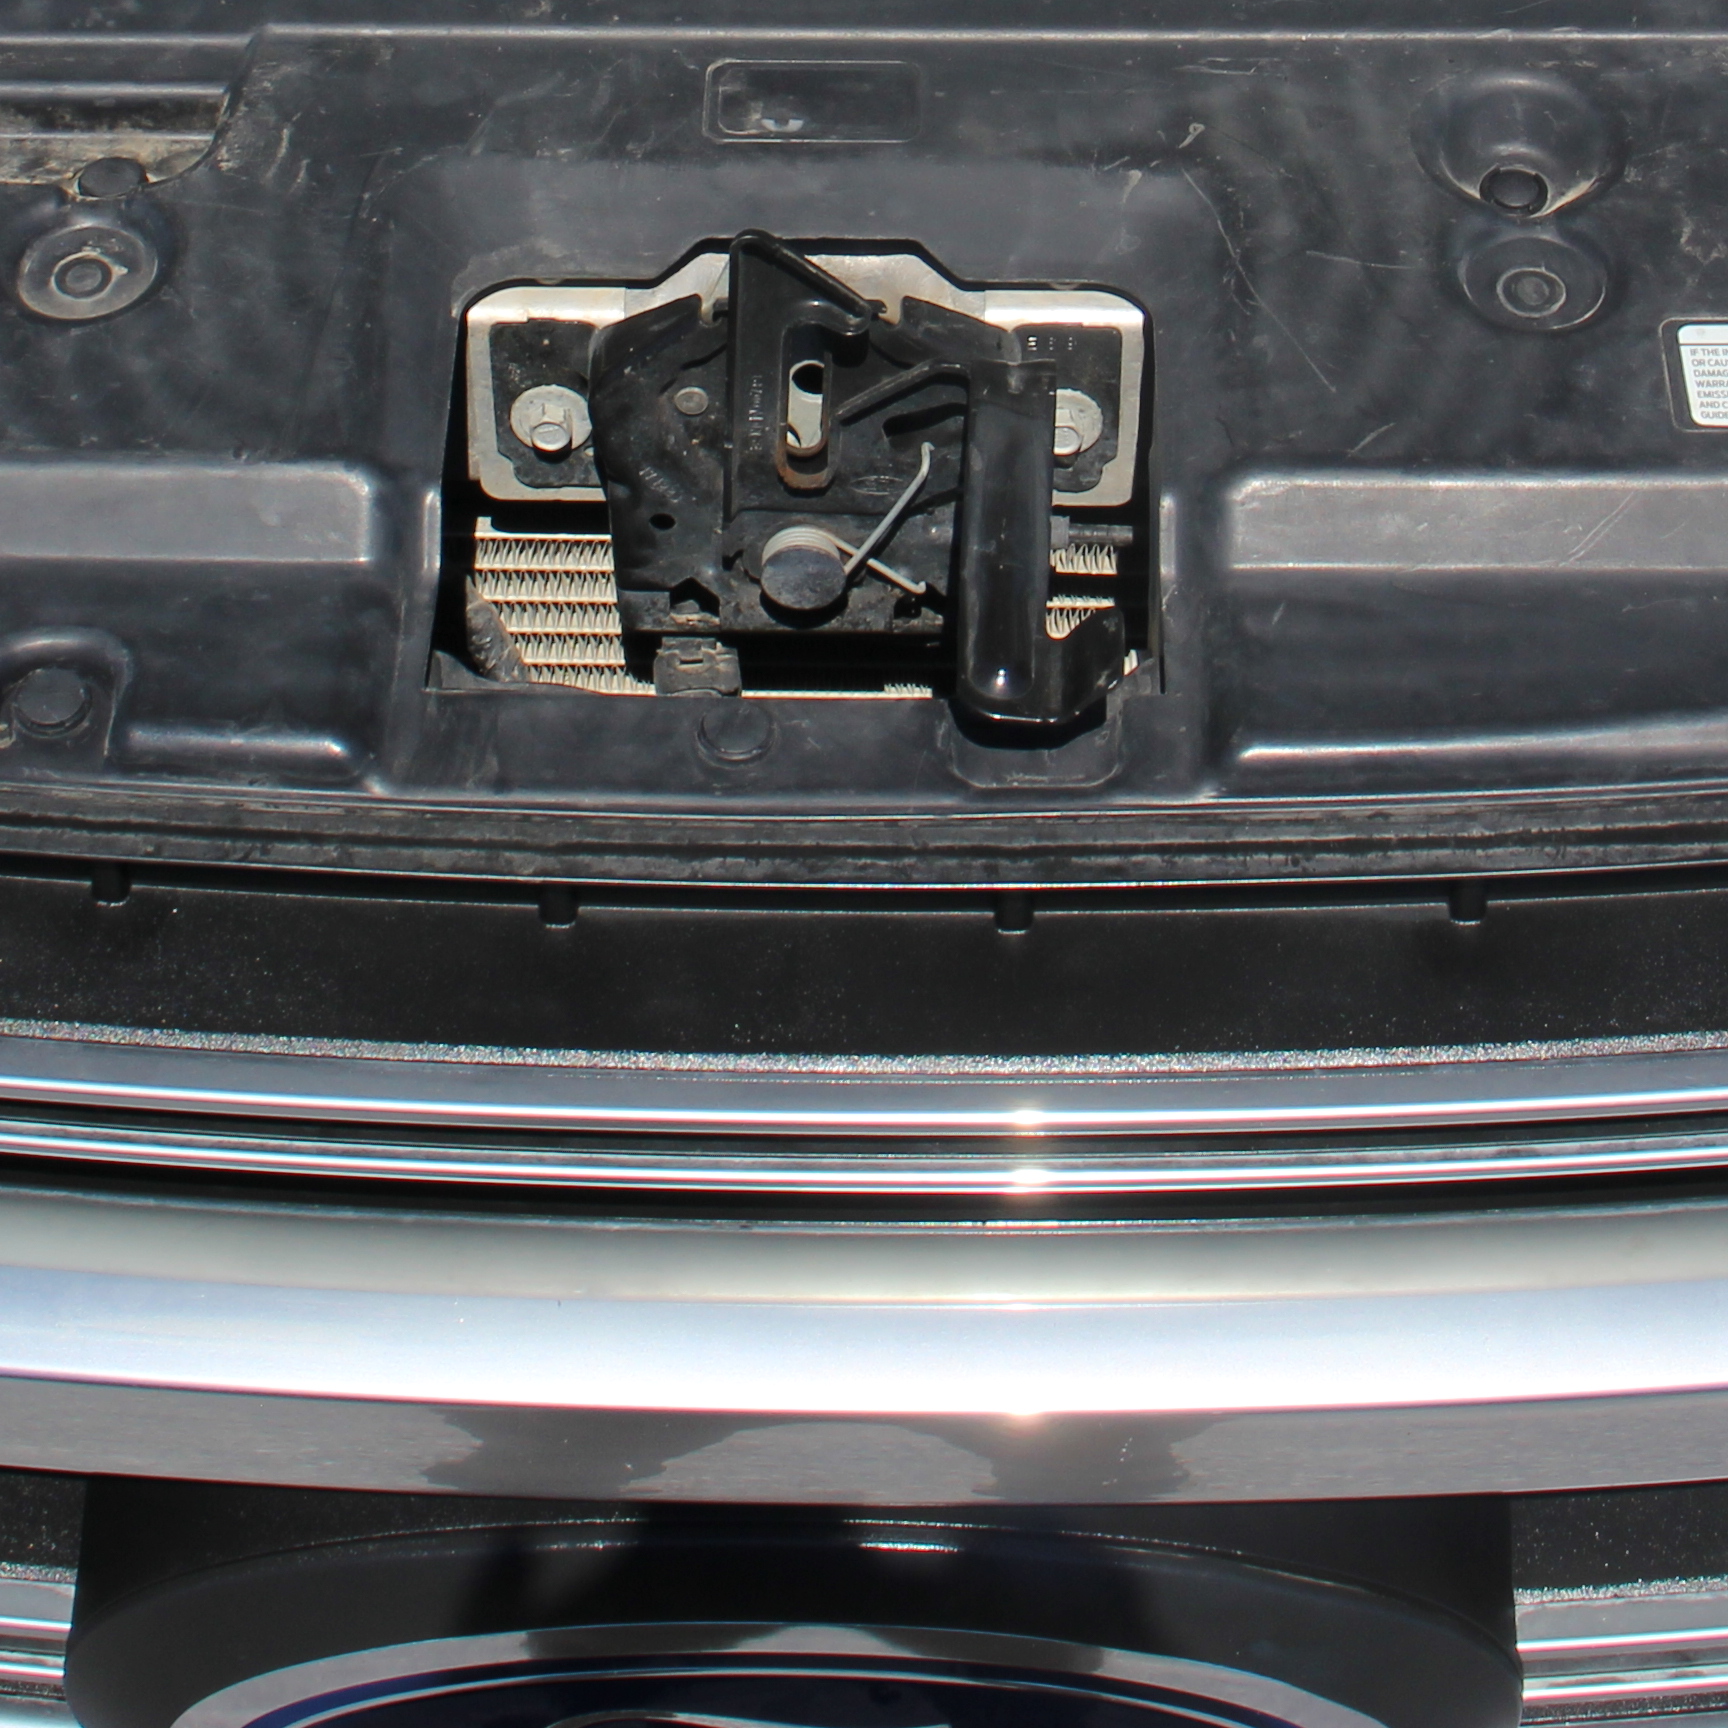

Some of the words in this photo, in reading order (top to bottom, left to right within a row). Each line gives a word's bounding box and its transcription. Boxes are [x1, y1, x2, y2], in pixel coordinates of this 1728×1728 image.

[1690, 348, 1699, 357] IF
[1701, 348, 1720, 357] THE
[1692, 359, 1706, 367] OR
[1699, 401, 1720, 409] AND
